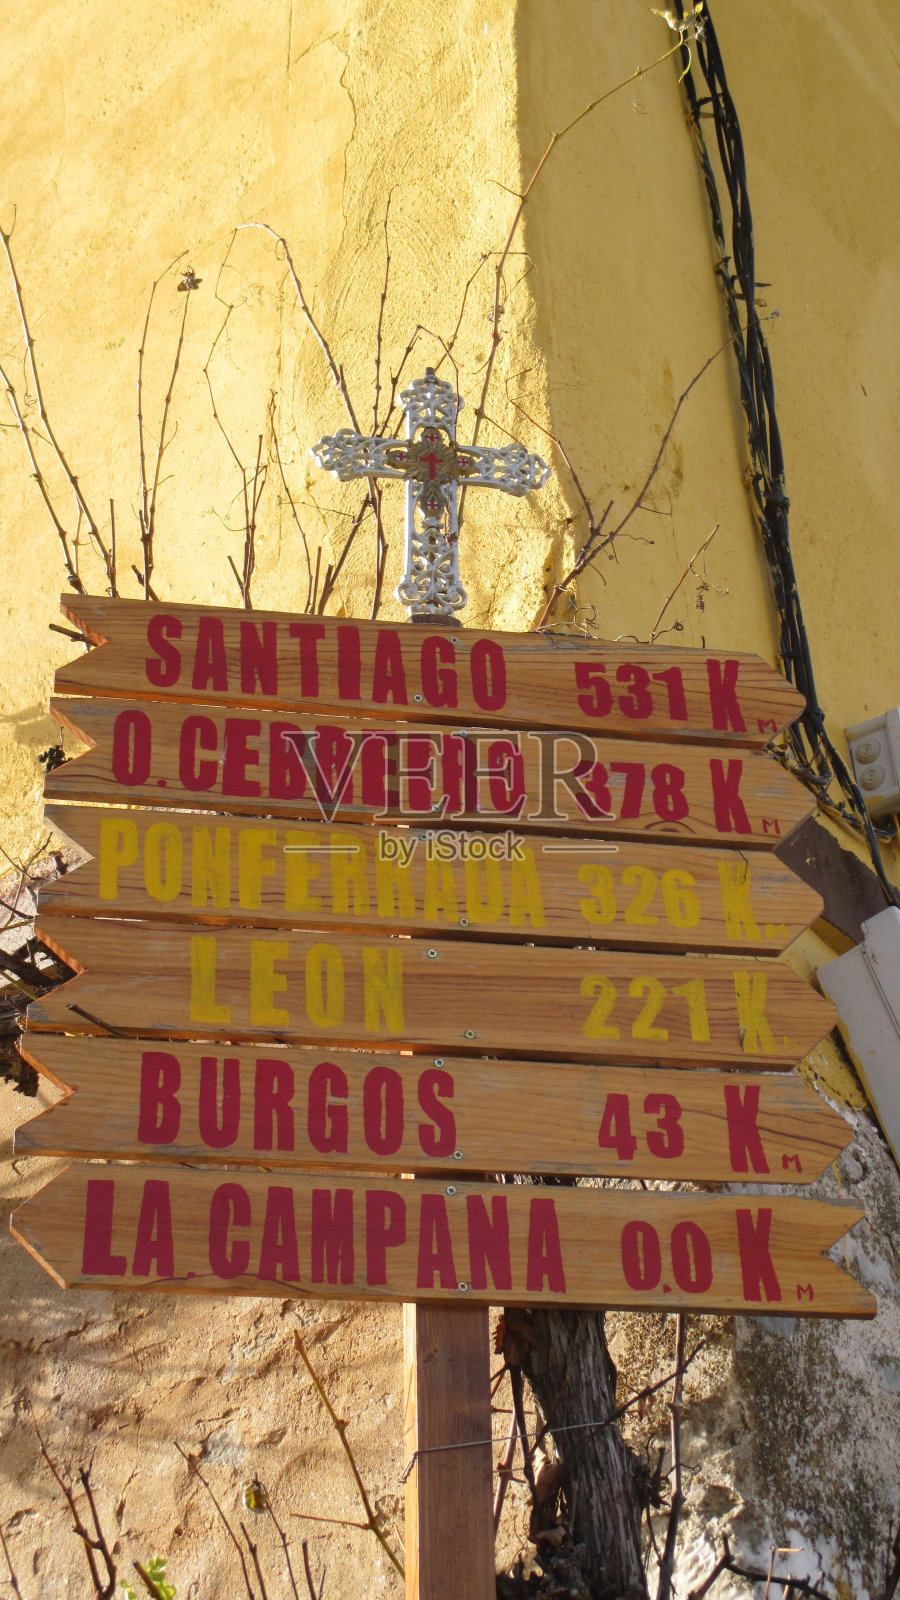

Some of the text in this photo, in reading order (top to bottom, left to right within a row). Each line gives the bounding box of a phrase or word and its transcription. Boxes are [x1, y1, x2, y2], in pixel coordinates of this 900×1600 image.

[145, 614, 507, 711] SANTIAGO
[574, 661, 688, 721] 531
[573, 760, 690, 821] 378
[99, 817, 546, 928] PONFERRADA
[577, 863, 700, 929] 326
[189, 935, 405, 1033] LEON
[580, 974, 711, 1042] 221
[137, 1051, 456, 1158] BURGOS
[598, 1093, 684, 1160] 43
